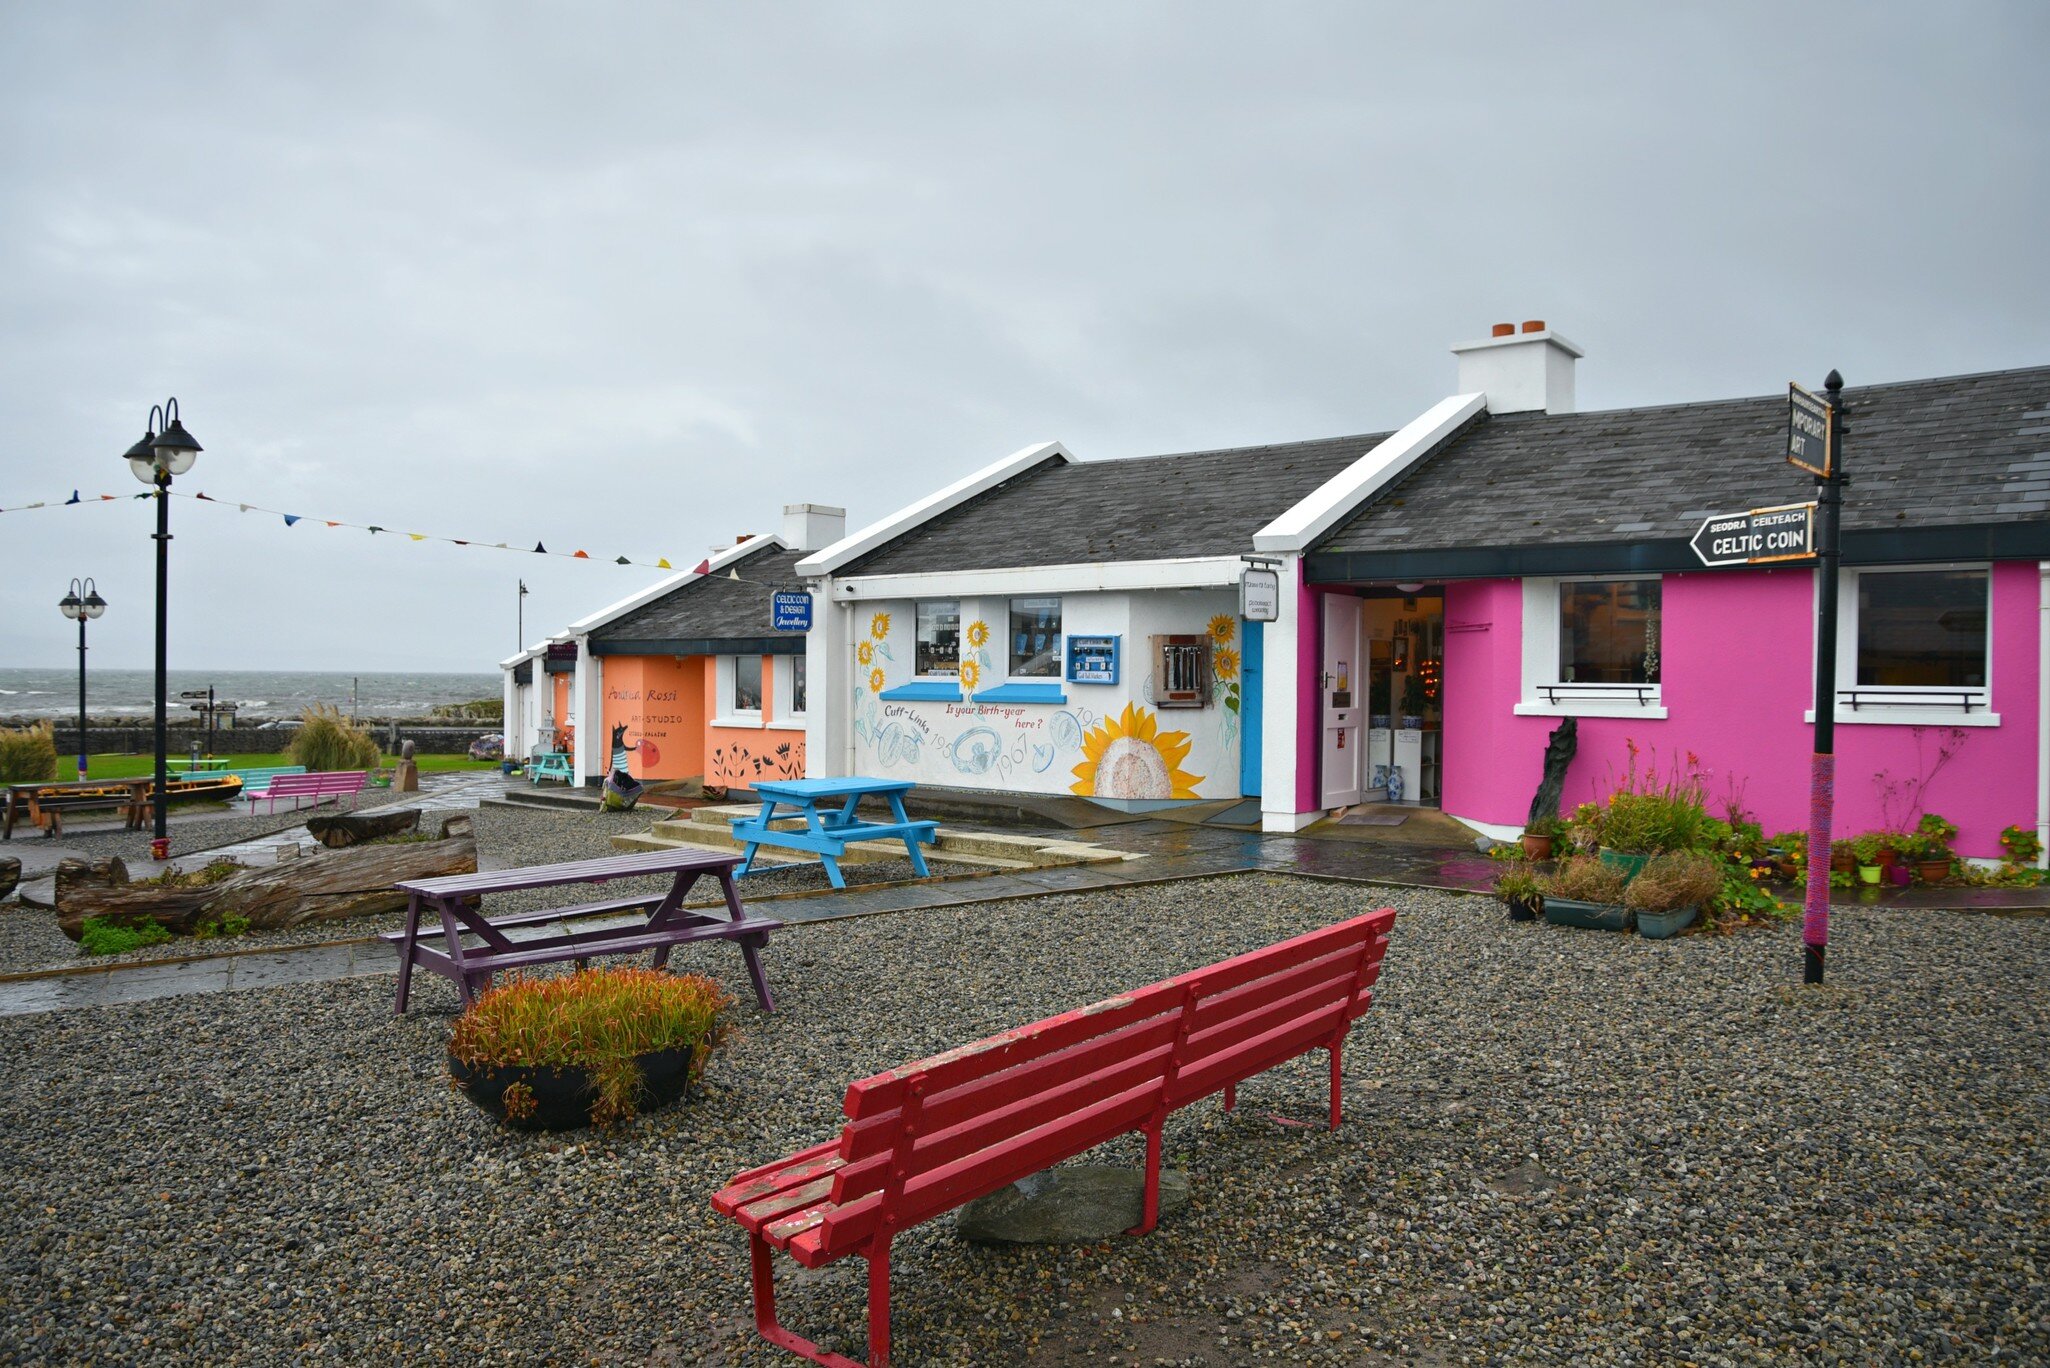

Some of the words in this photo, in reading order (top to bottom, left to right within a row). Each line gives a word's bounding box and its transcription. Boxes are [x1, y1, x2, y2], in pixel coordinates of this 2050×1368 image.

[1791, 434, 1806, 456] ART
[1710, 520, 1747, 533] SEODRA
[1752, 512, 1806, 528] CEILTEACH
[1713, 534, 1763, 555] CELTIC
[1767, 529, 1804, 549] COIN
[785, 605, 806, 614] DESIGN
[776, 616, 808, 628] Jewellery
[646, 689, 677, 702] Rossi
[646, 715, 683, 723] STUDIO
[885, 704, 930, 734] Cuff-Links
[946, 704, 955, 714] Is
[955, 707, 976, 717] your
[978, 704, 1026, 719] Birth-year
